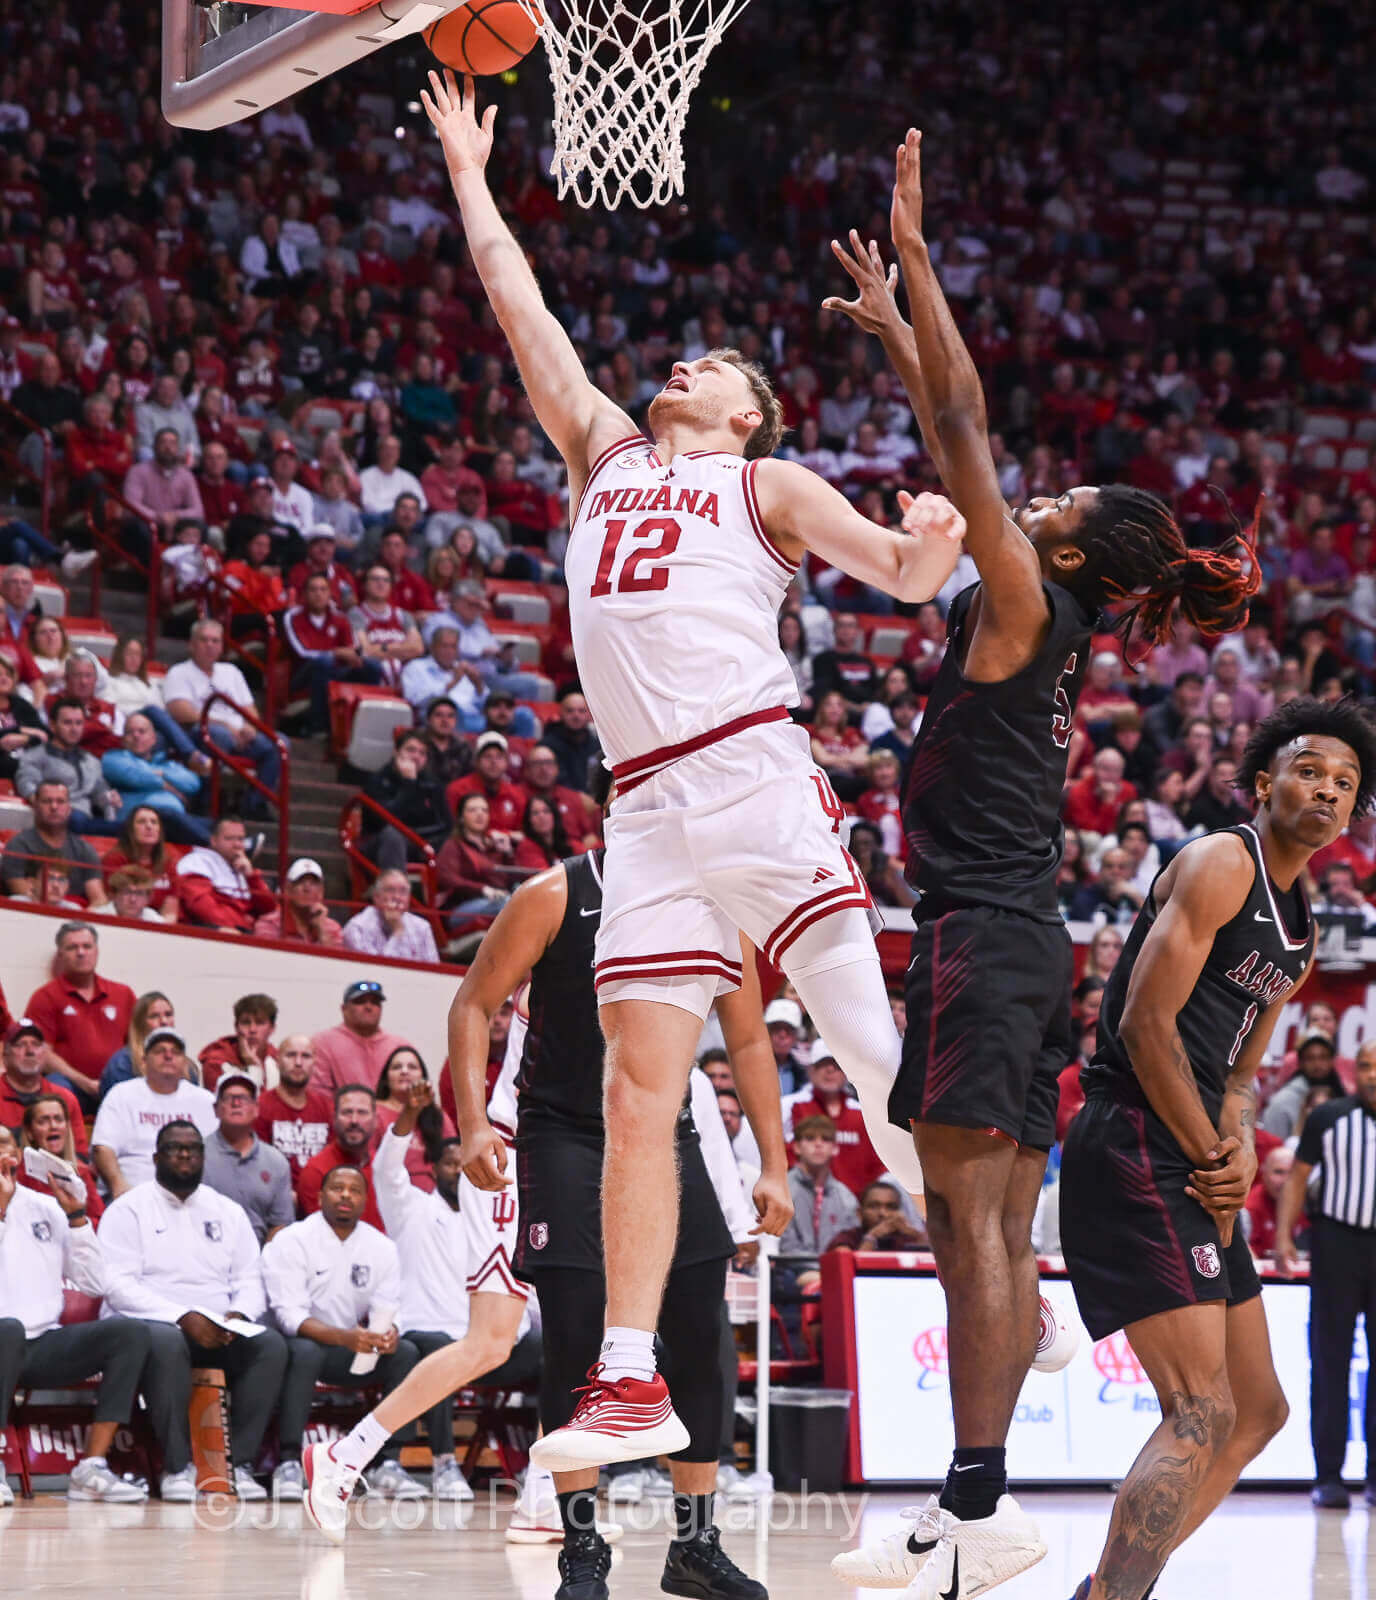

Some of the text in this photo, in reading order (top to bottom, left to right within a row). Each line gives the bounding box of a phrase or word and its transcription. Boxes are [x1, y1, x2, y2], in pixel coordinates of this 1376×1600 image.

[586, 485, 719, 527] INDIANA
[590, 518, 682, 597] 12
[1226, 950, 1294, 1005] AAM
